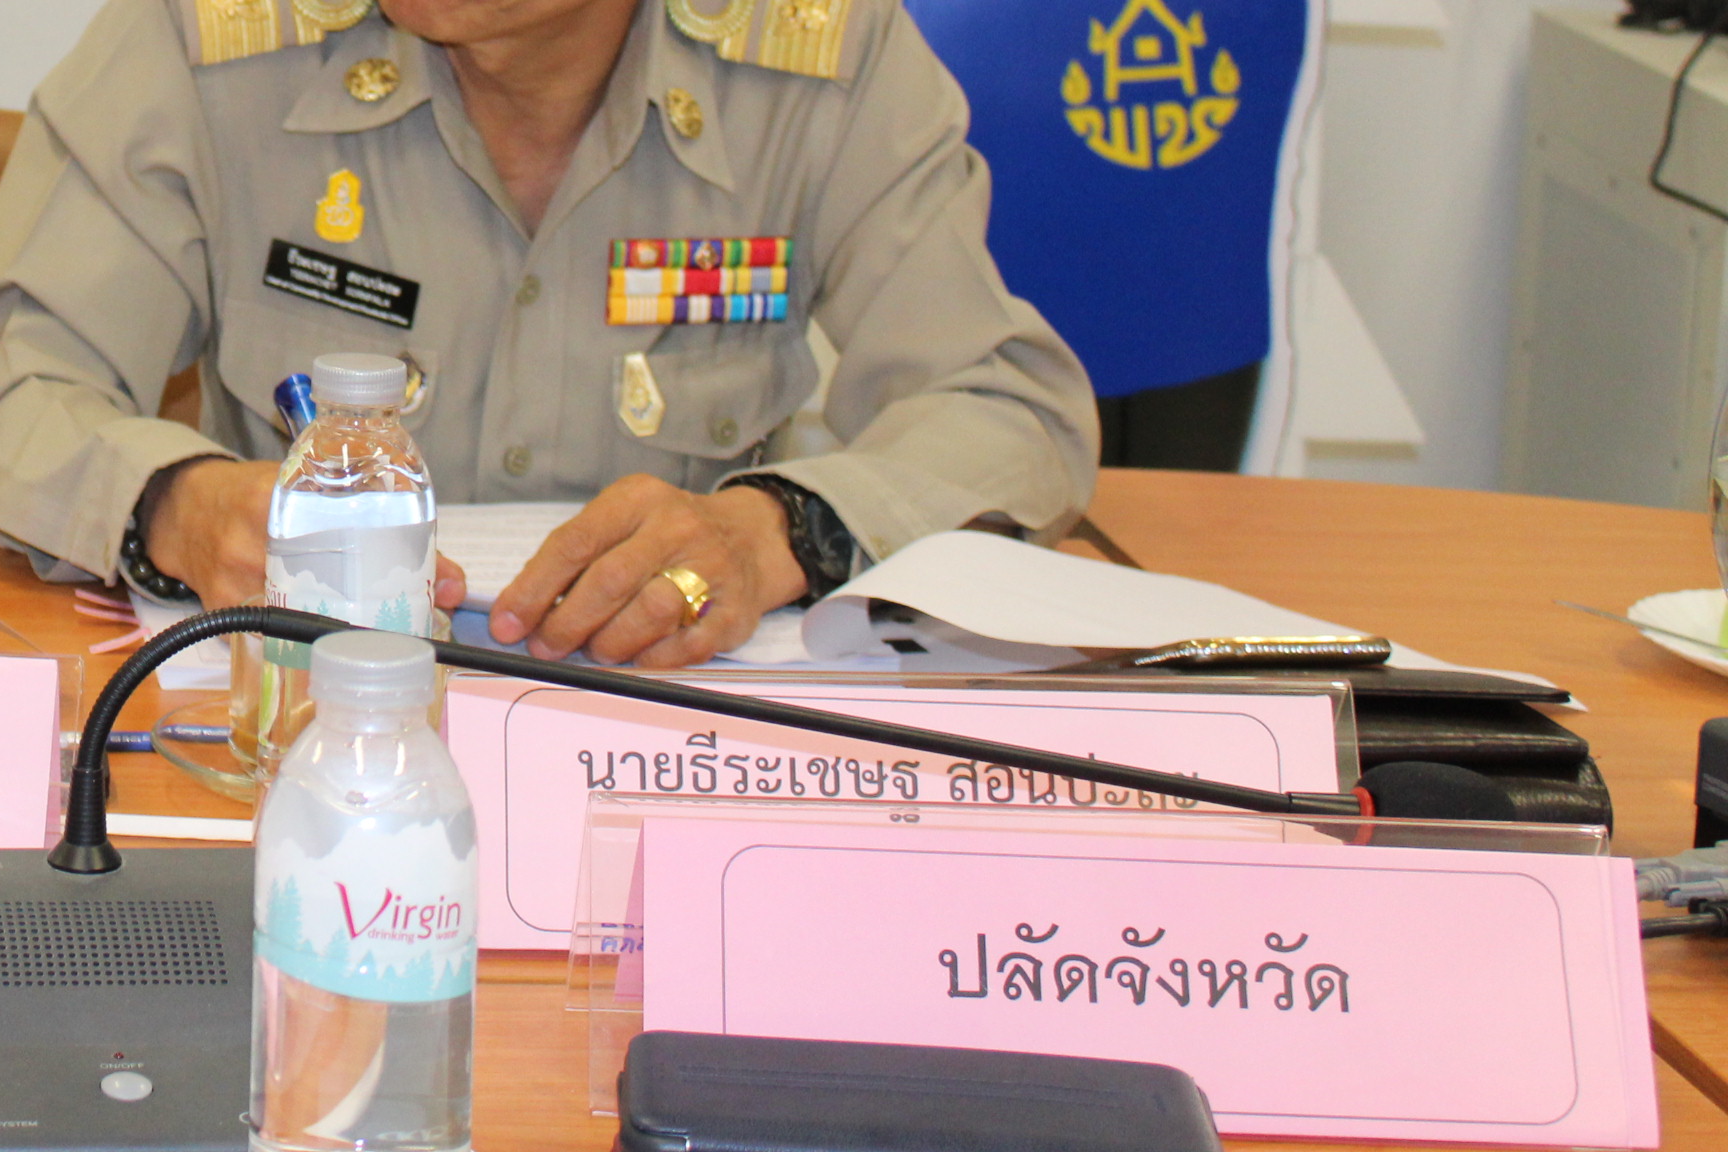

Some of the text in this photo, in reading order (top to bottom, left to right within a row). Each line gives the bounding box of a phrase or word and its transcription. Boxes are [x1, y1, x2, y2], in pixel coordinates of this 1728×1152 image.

[577, 730, 921, 823] นายธีระเชษฐ
[333, 881, 462, 940] Virgin
[367, 929, 416, 945] drinking
[938, 922, 1351, 1014] ปลัดจังหวัด
[99, 1062, 145, 1070] ON/OFF
